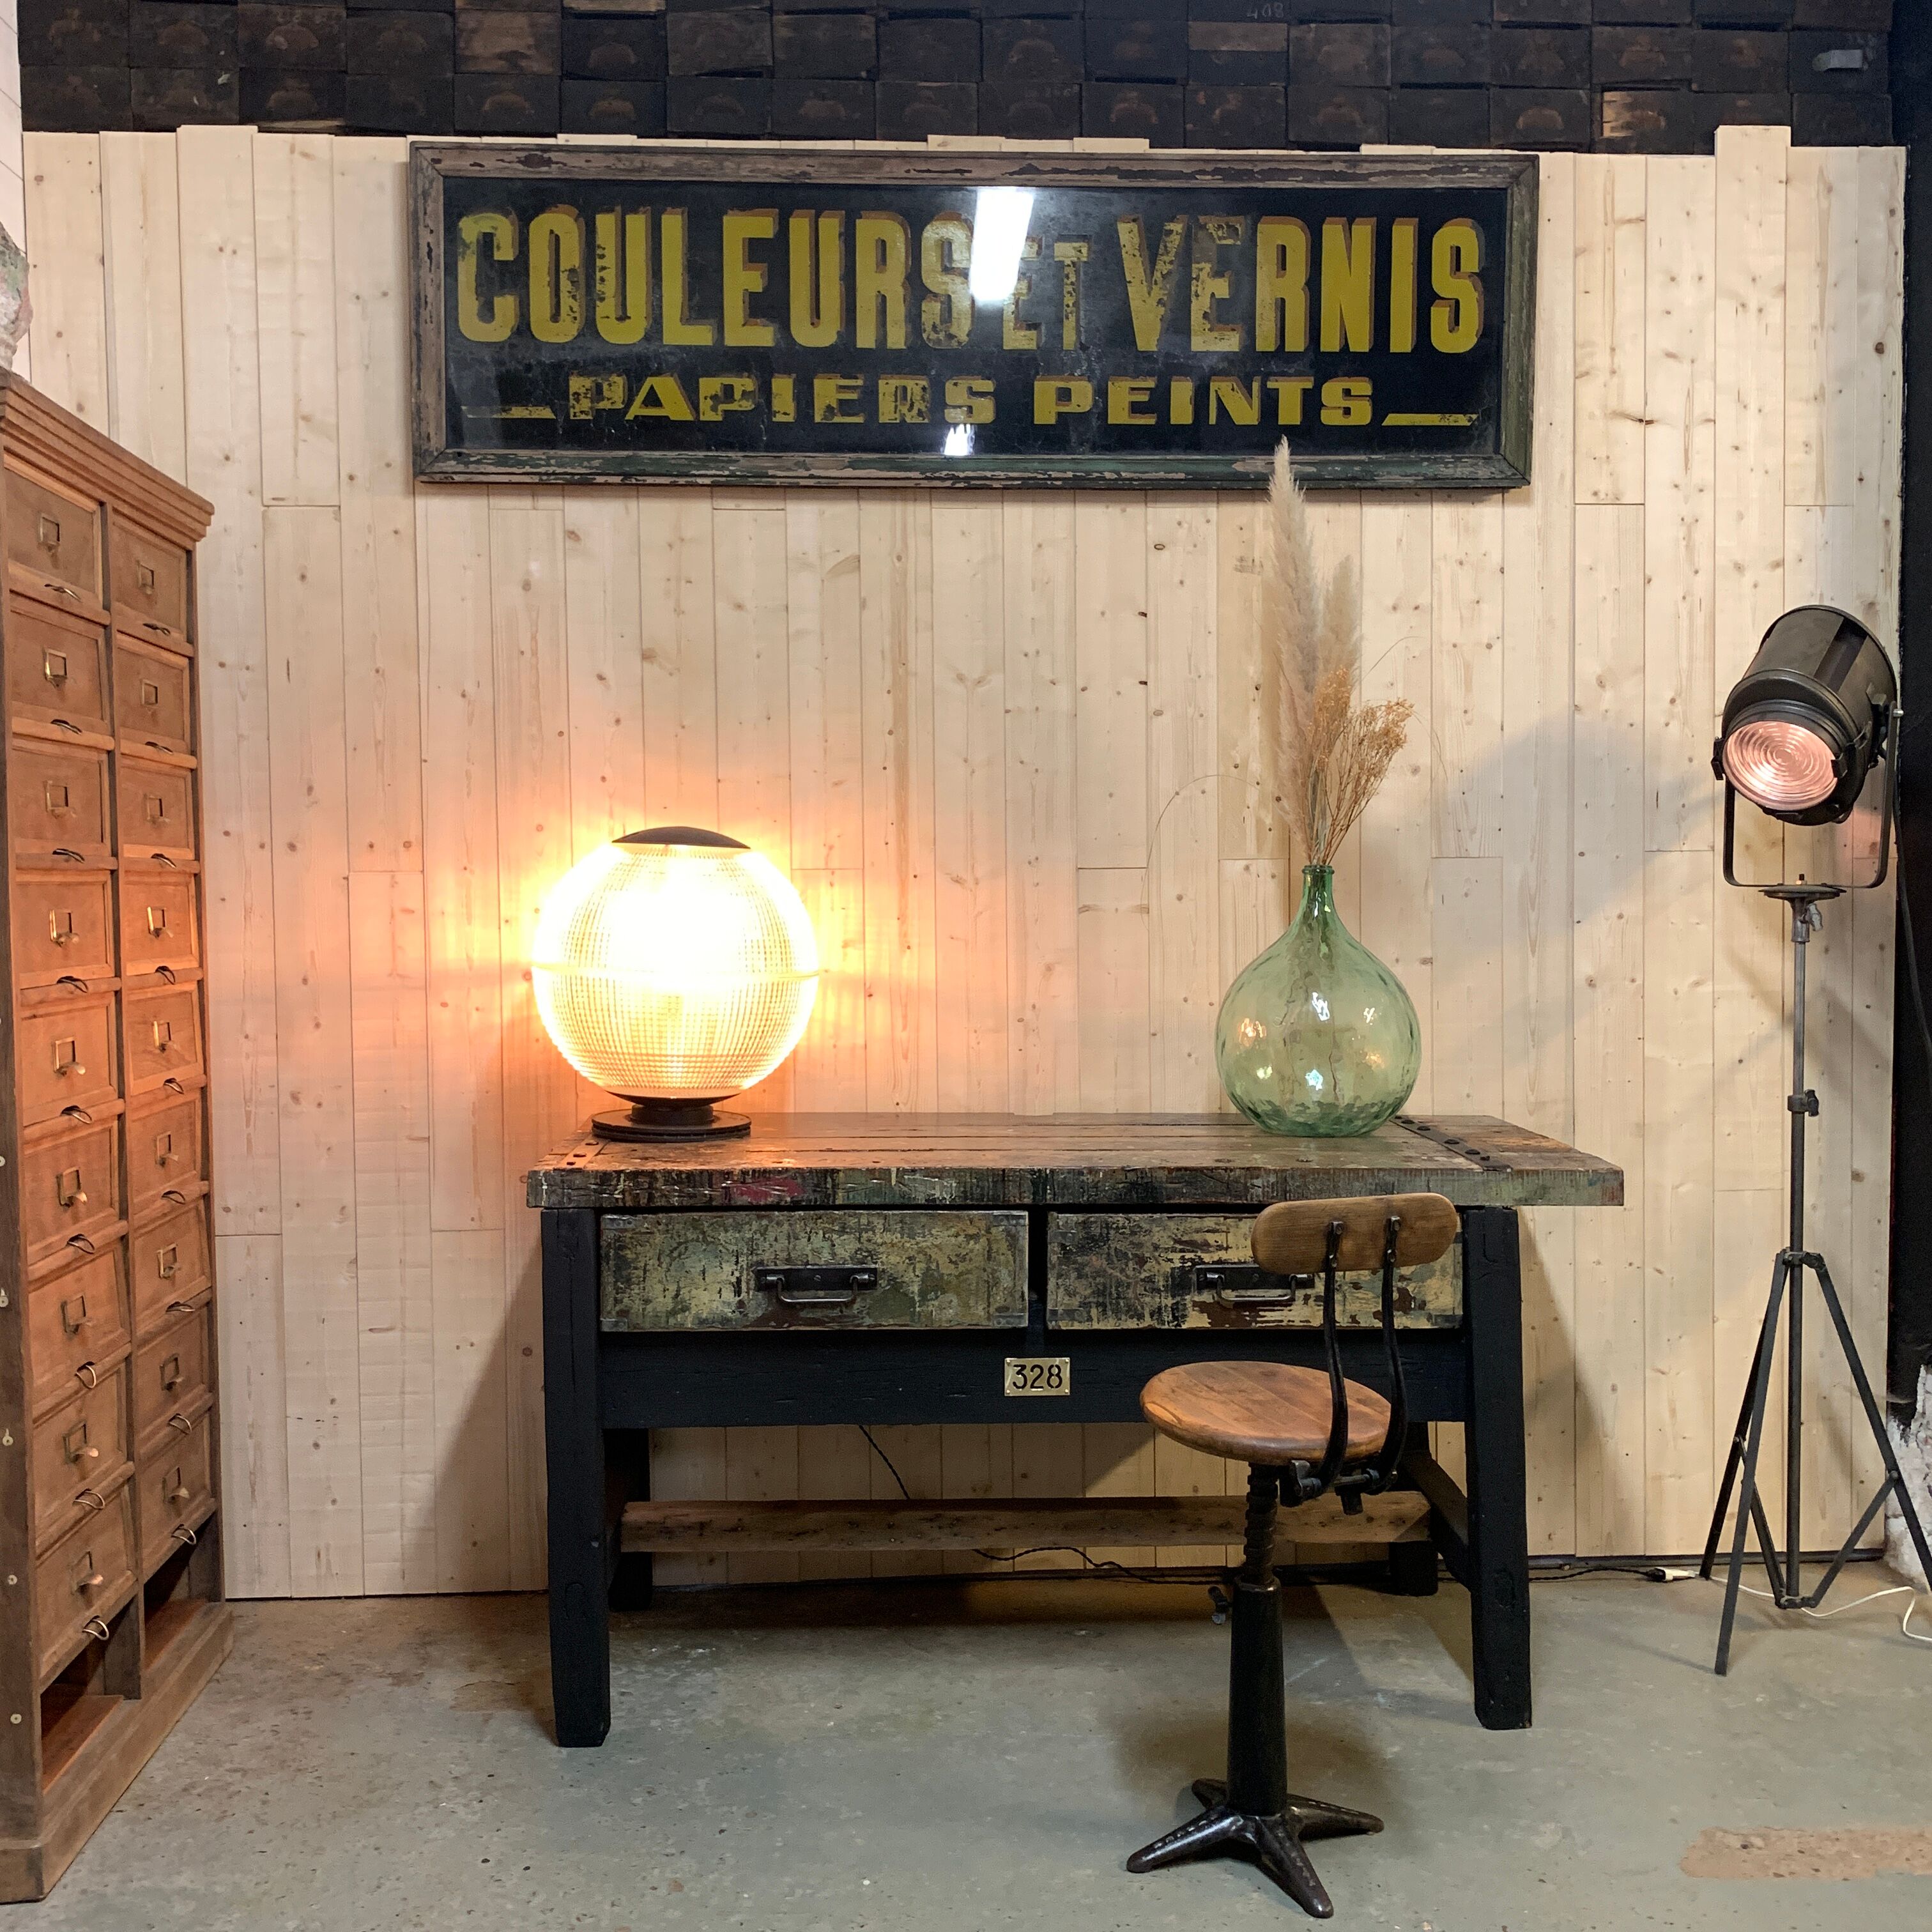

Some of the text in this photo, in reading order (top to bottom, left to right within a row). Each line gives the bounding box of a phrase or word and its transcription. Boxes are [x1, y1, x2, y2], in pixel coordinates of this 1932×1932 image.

[457, 204, 975, 349] COULEURS
[1116, 214, 1484, 353] VERNIS
[569, 371, 1373, 426] PAPIERS PEINTS
[1012, 1364, 1063, 1389] 328
